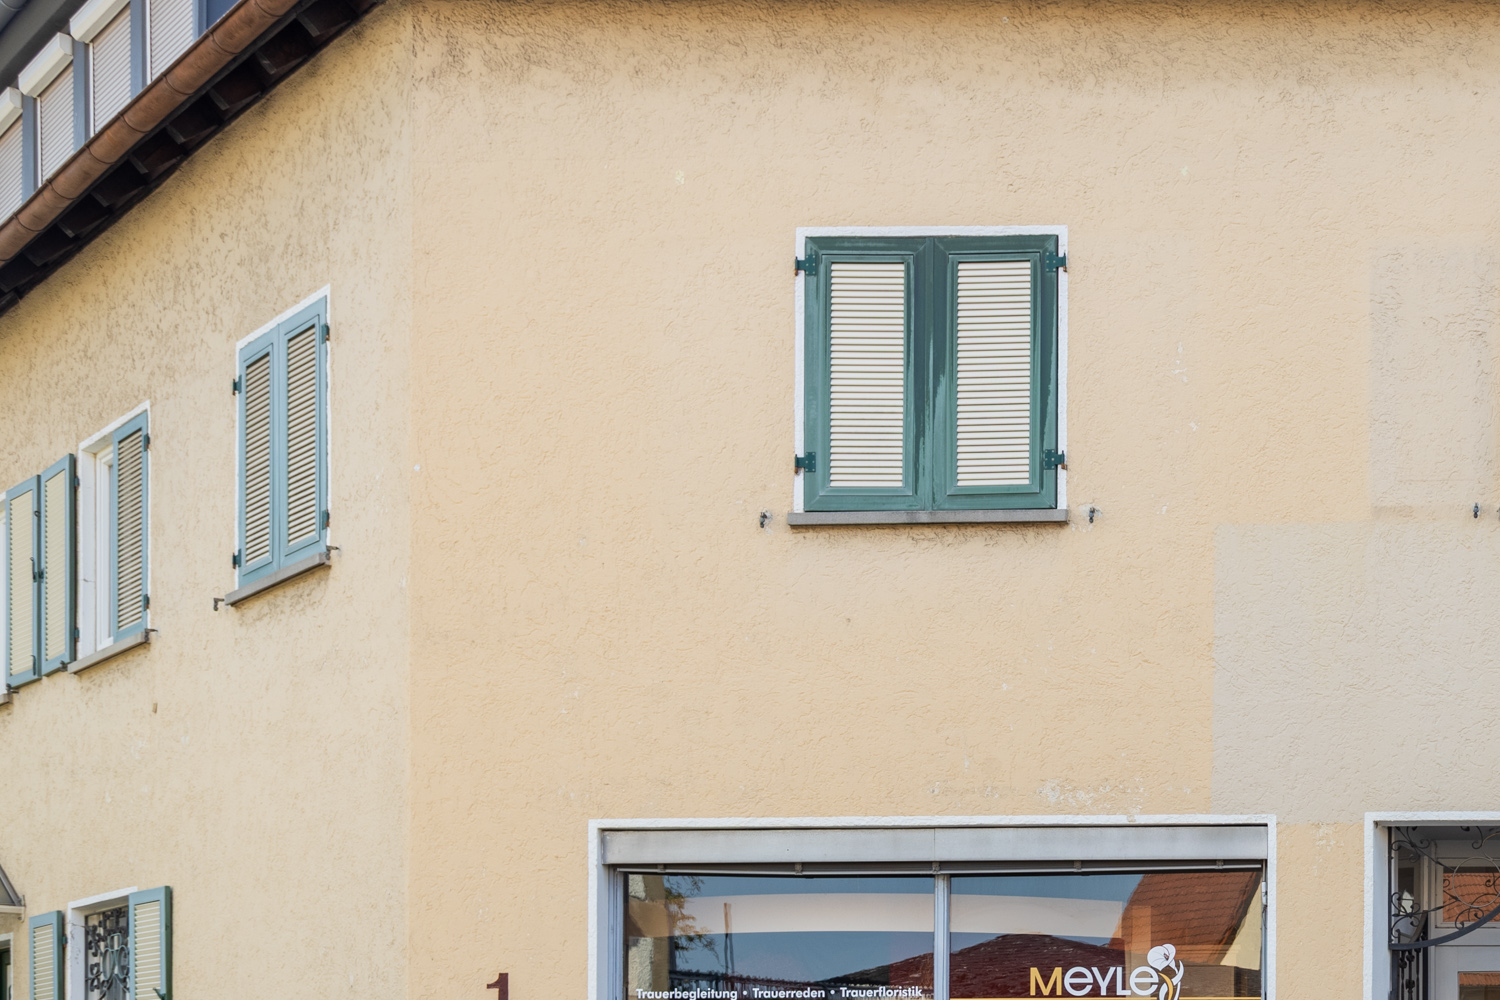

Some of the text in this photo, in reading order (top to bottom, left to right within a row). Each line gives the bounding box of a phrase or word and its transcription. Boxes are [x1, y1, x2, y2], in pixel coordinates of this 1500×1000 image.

[636, 986, 922, 1000] Trauerbegleitung Trauerreden Trauerfloristik
